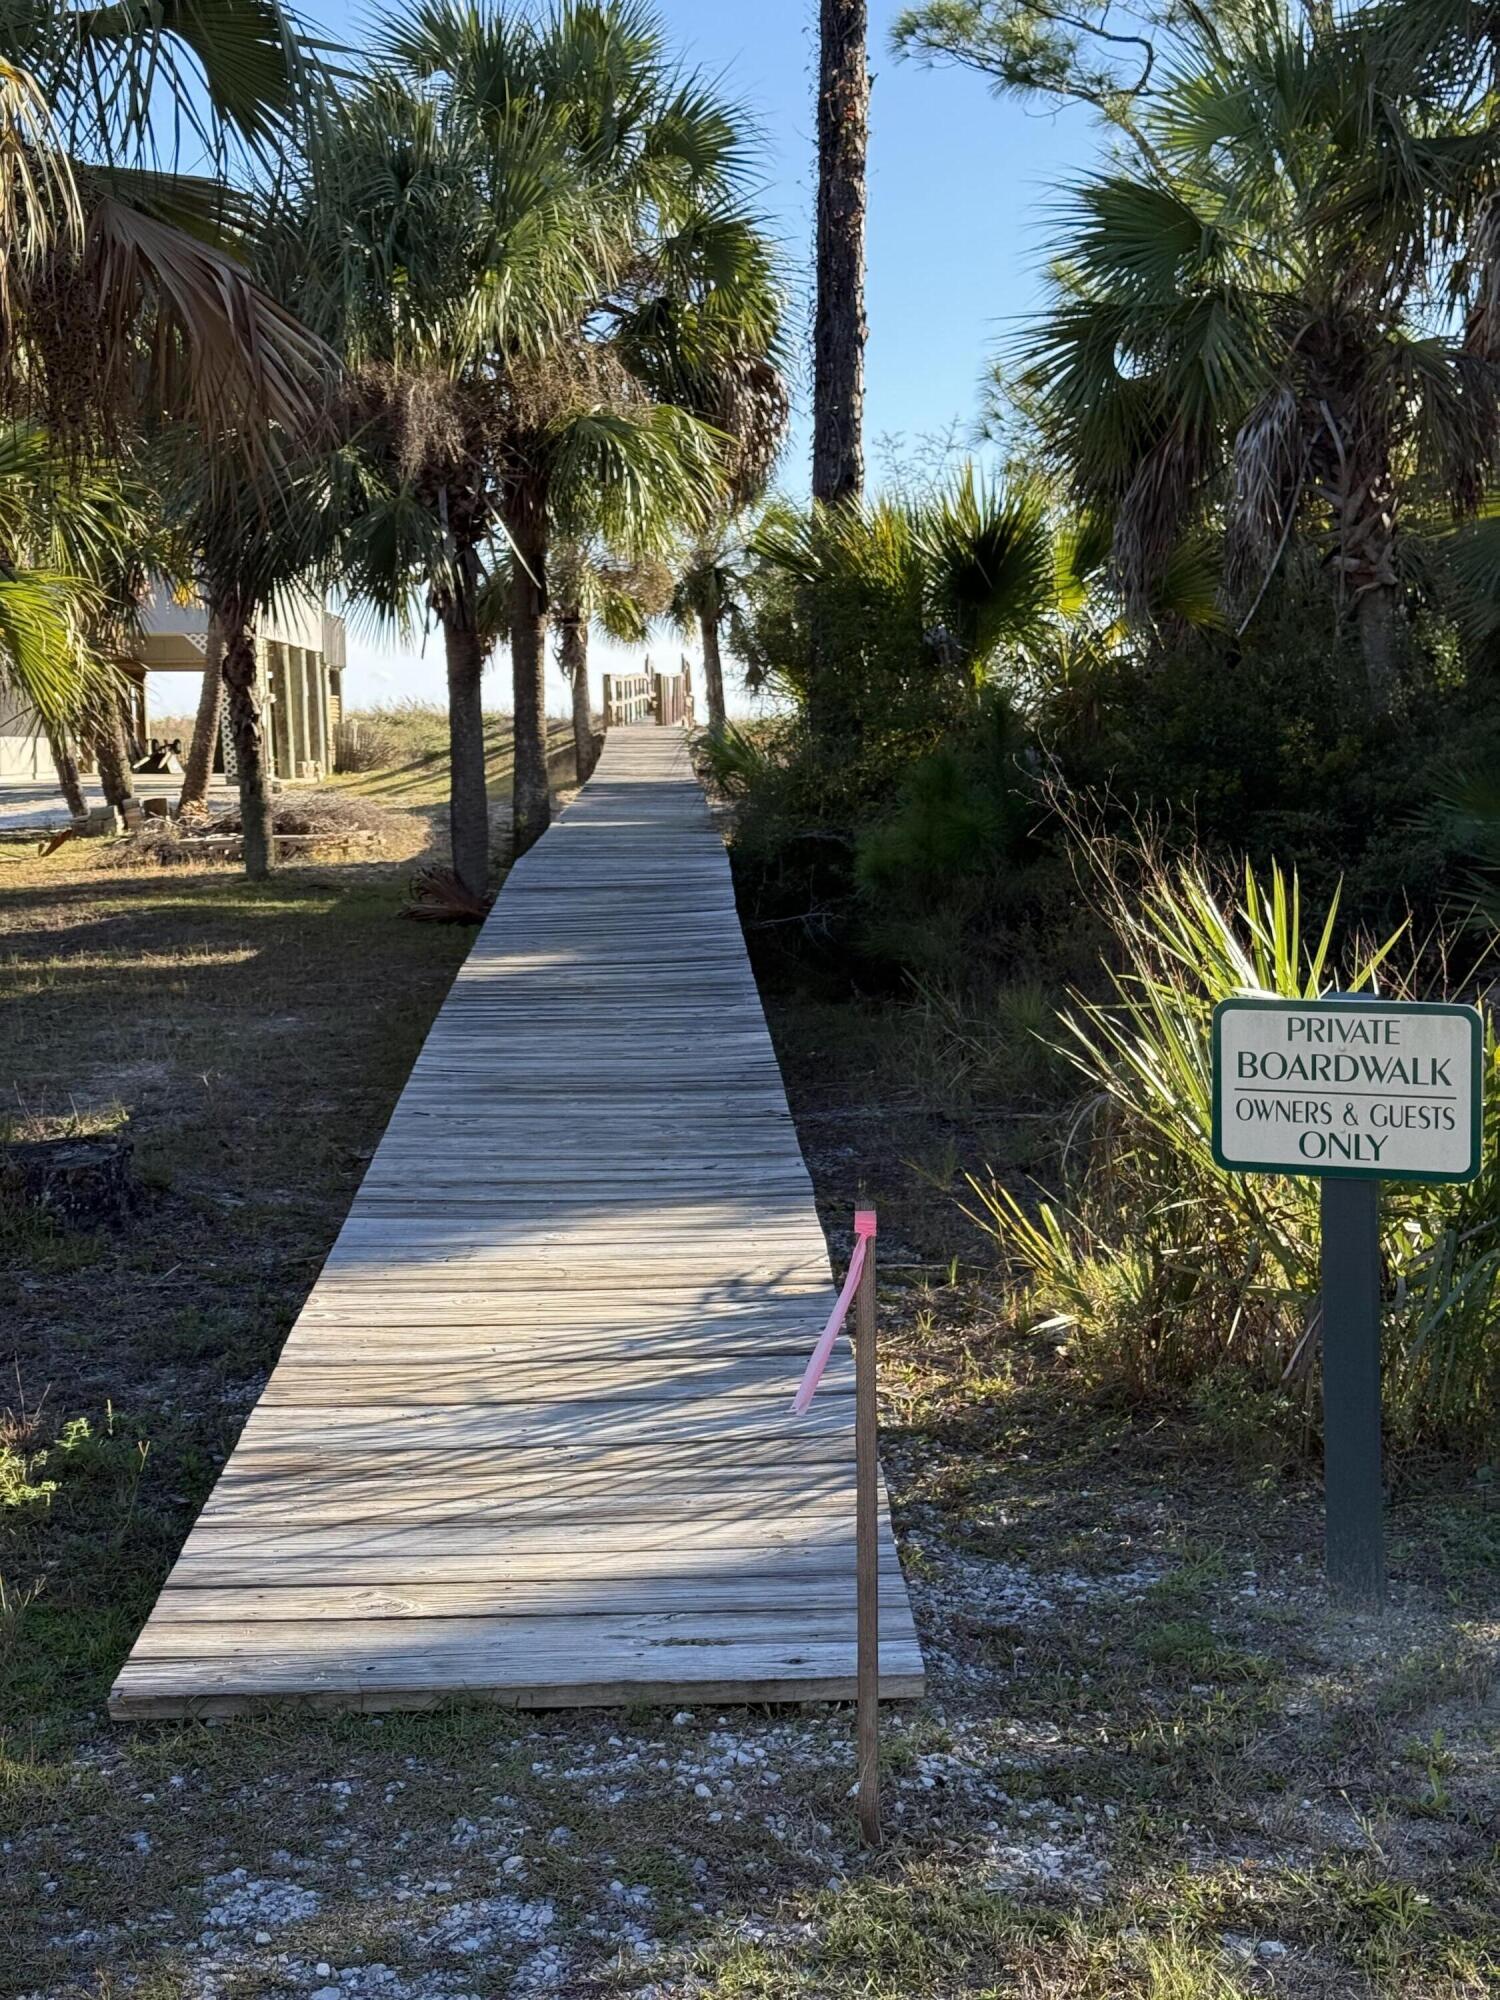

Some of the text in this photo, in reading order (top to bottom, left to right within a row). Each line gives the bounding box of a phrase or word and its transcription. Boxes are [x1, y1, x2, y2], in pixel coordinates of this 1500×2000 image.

[1287, 1017, 1400, 1045] PRIVATE
[1237, 1051, 1452, 1087] BOARDWALK
[1235, 1098, 1455, 1130] OWNERS & GUESTS
[1299, 1131, 1389, 1161] ONLY
